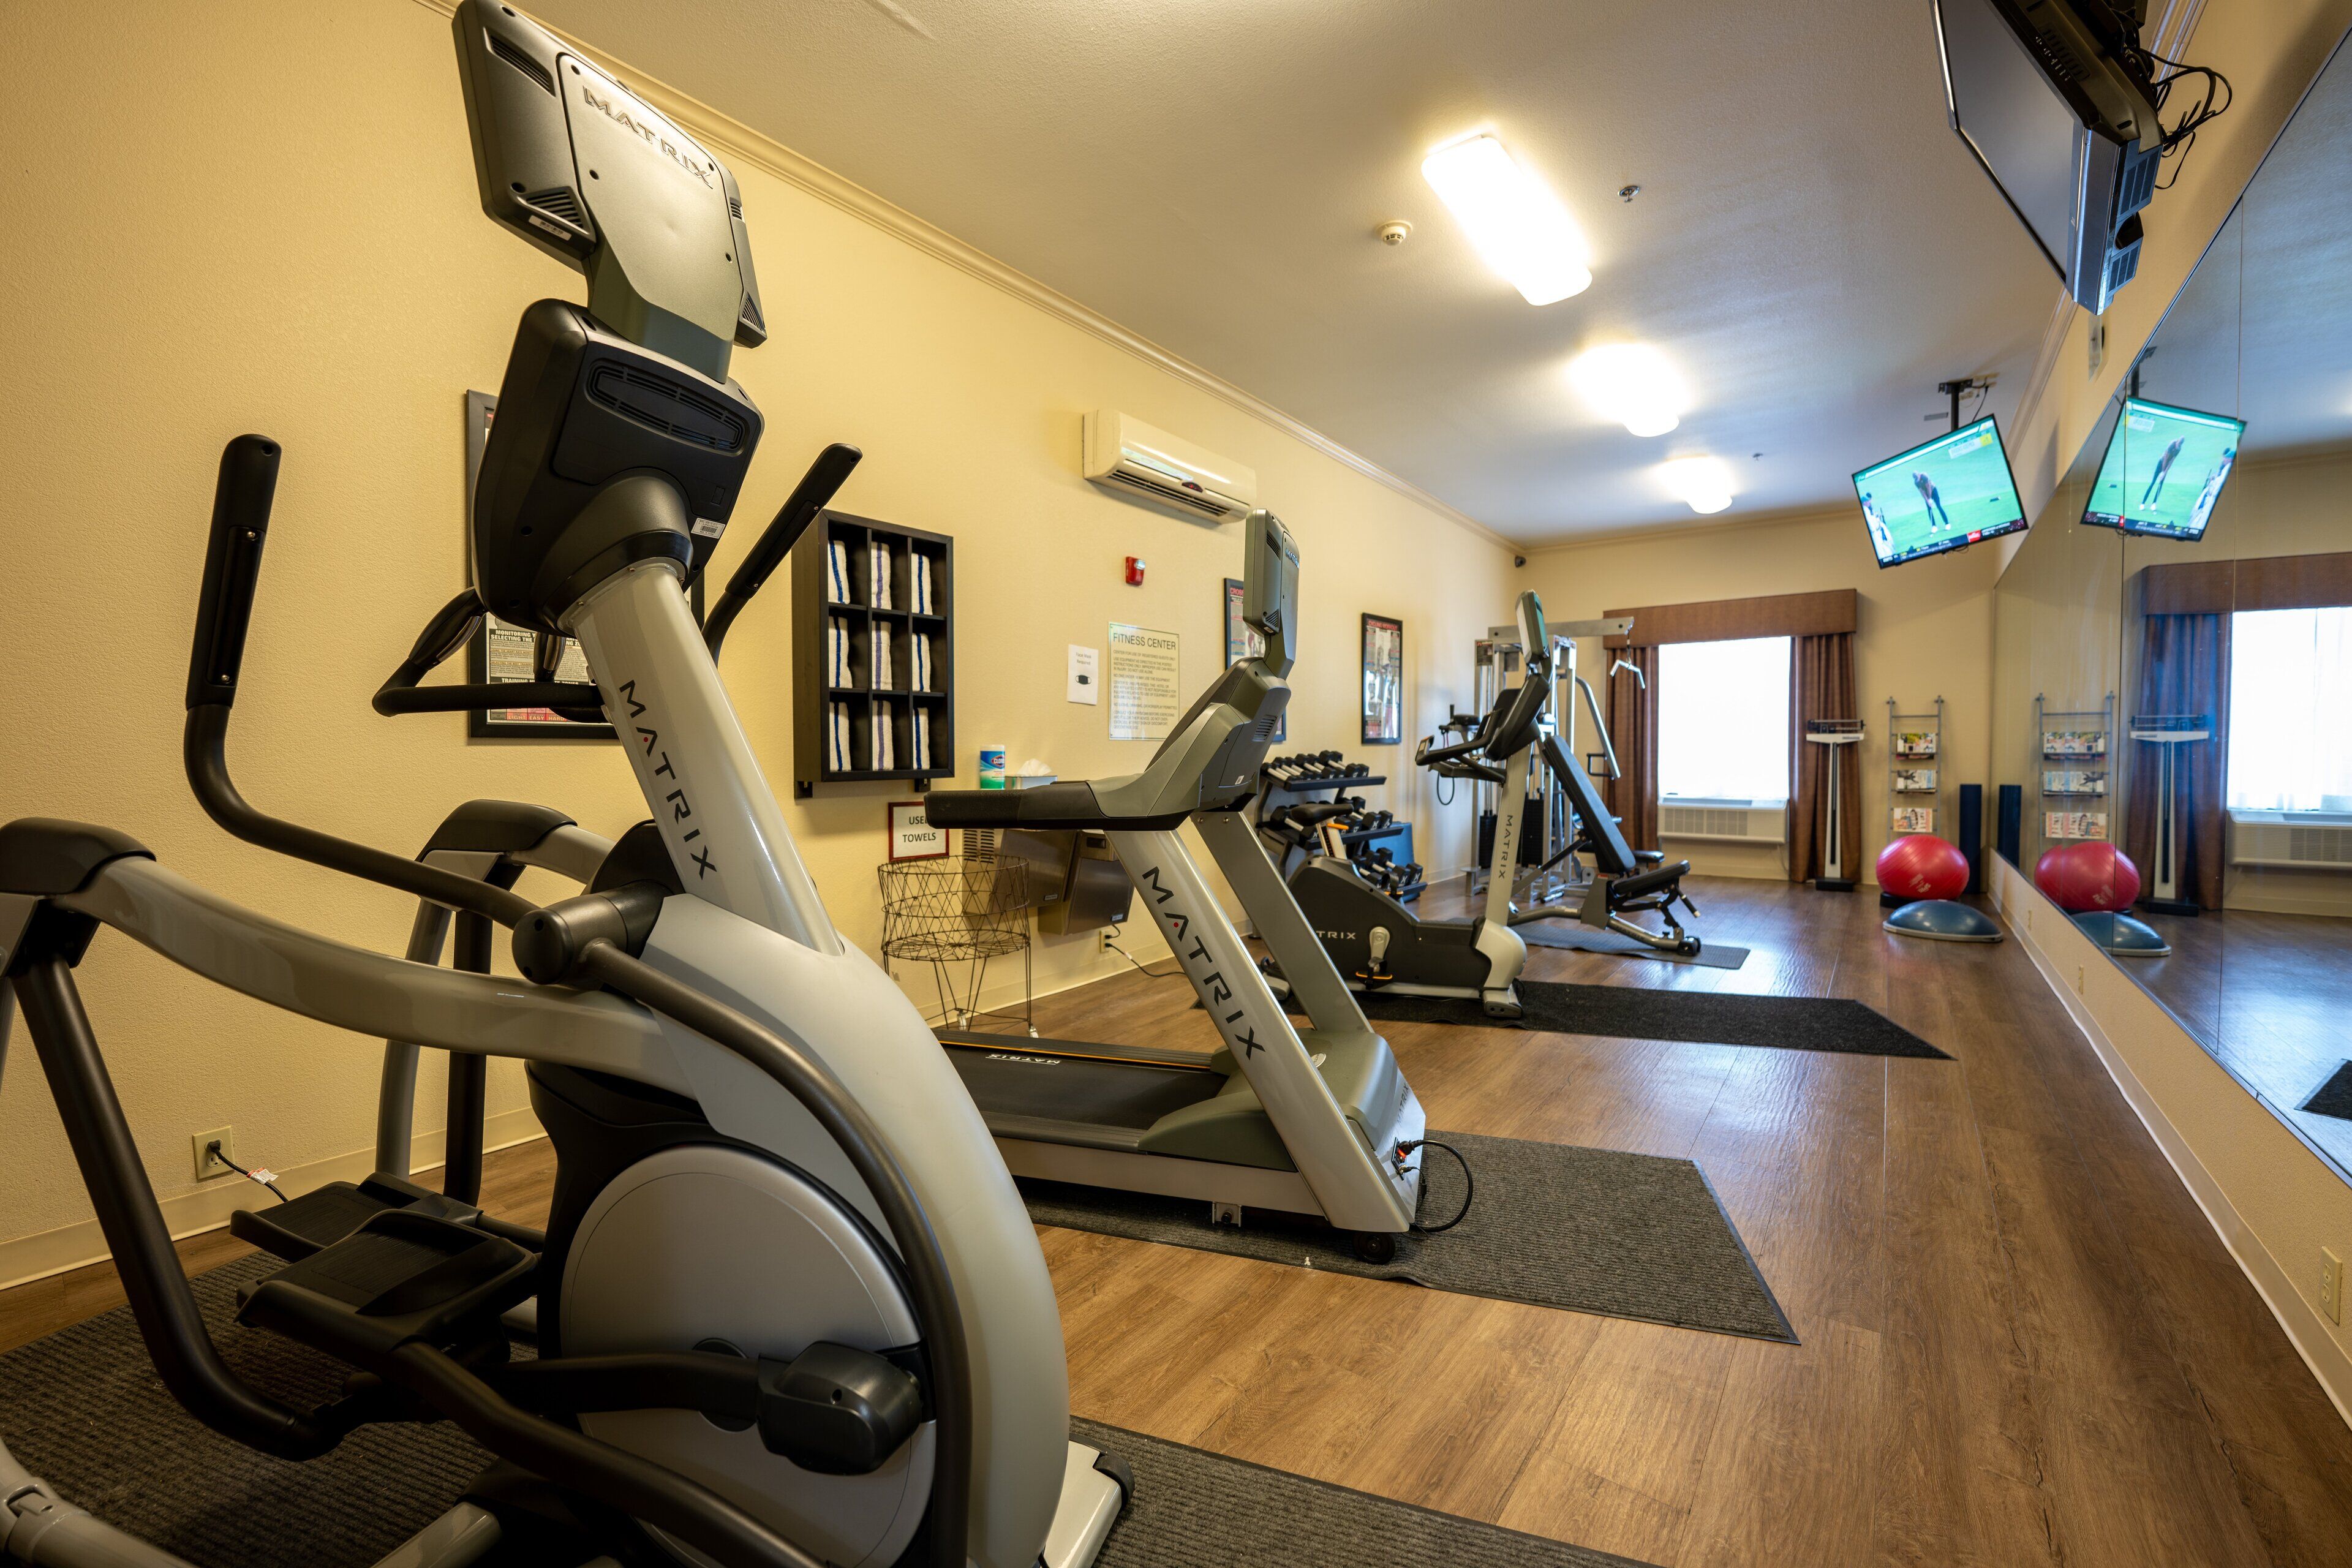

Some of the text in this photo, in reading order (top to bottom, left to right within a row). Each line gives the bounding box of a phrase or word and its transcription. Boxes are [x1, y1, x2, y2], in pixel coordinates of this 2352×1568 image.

[582, 85, 713, 189] MATRIX
[1114, 633, 1176, 650] FITNESS CENTER
[619, 679, 717, 881] MATRIX
[903, 832, 936, 842] TOWELS
[1499, 815, 1513, 879] MATRIX
[1142, 866, 1265, 1060] MATRIX
[989, 1054, 1061, 1064] MATRIX
[1397, 1082, 1409, 1126] MATRIX
